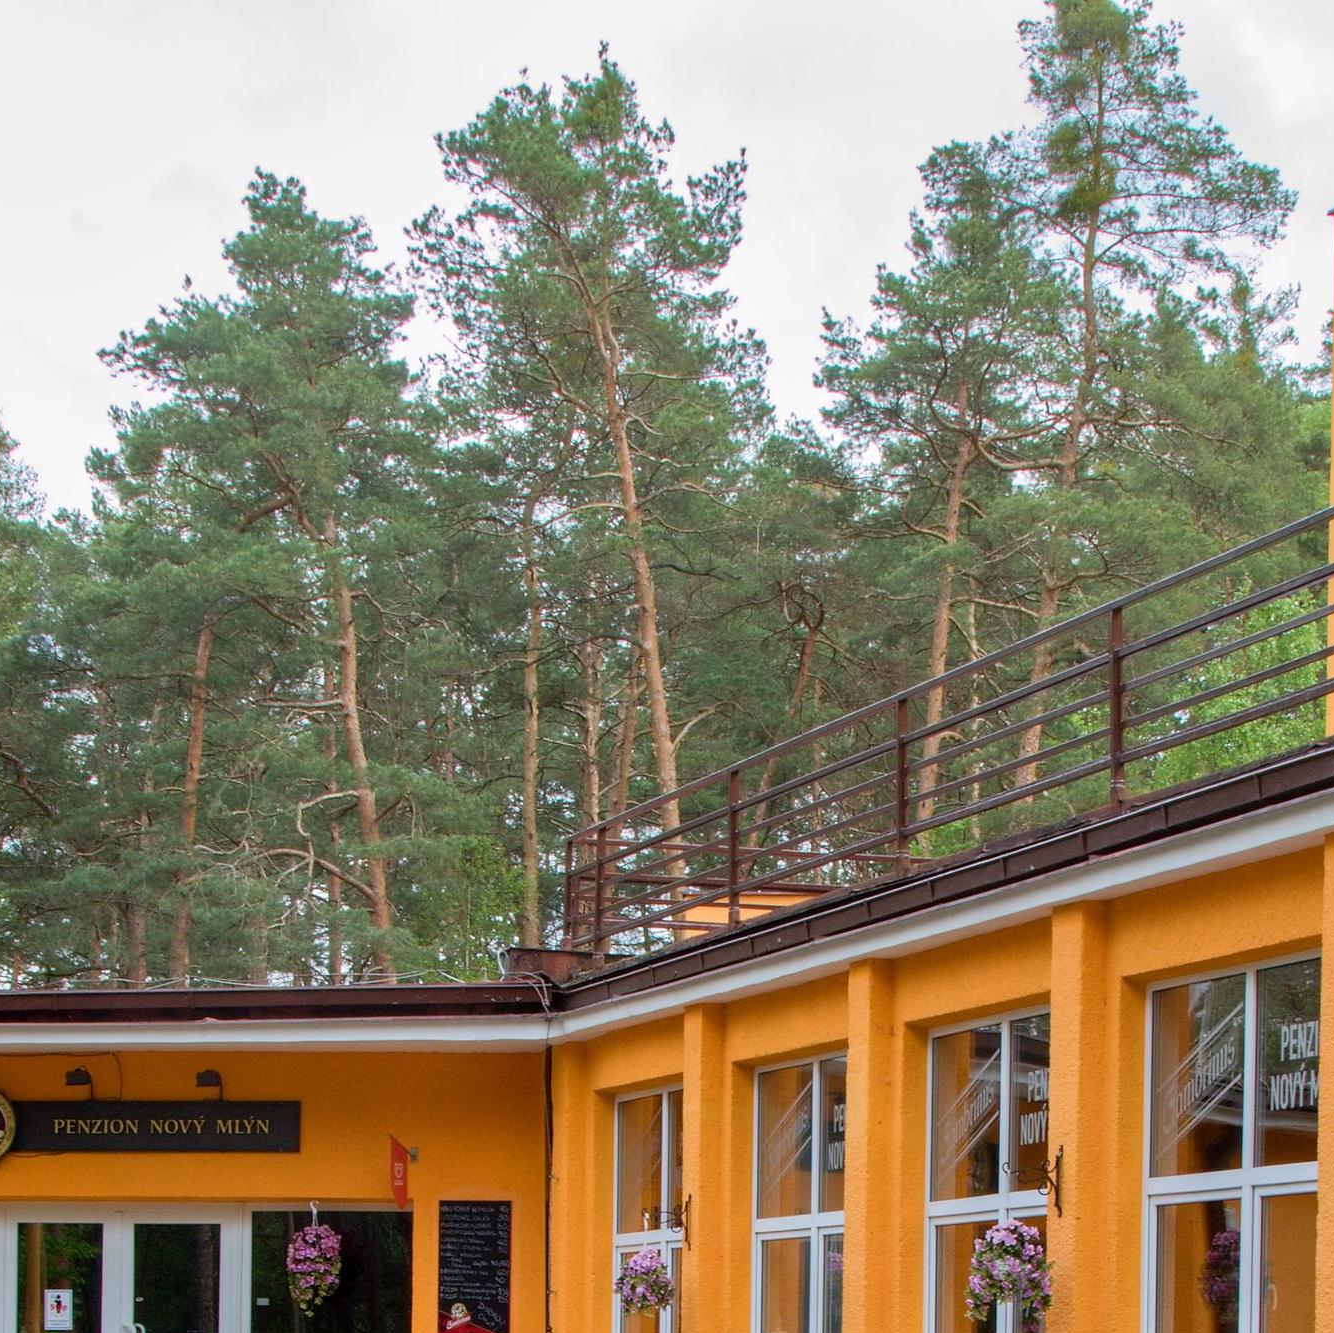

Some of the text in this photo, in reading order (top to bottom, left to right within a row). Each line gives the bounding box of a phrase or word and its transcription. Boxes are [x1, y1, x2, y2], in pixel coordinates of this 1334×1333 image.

[1270, 1062, 1306, 1112] NOVÝ
[53, 1115, 270, 1134] PENZION NOVÝ MLÝN
[1020, 1103, 1047, 1146] NOVÝ
